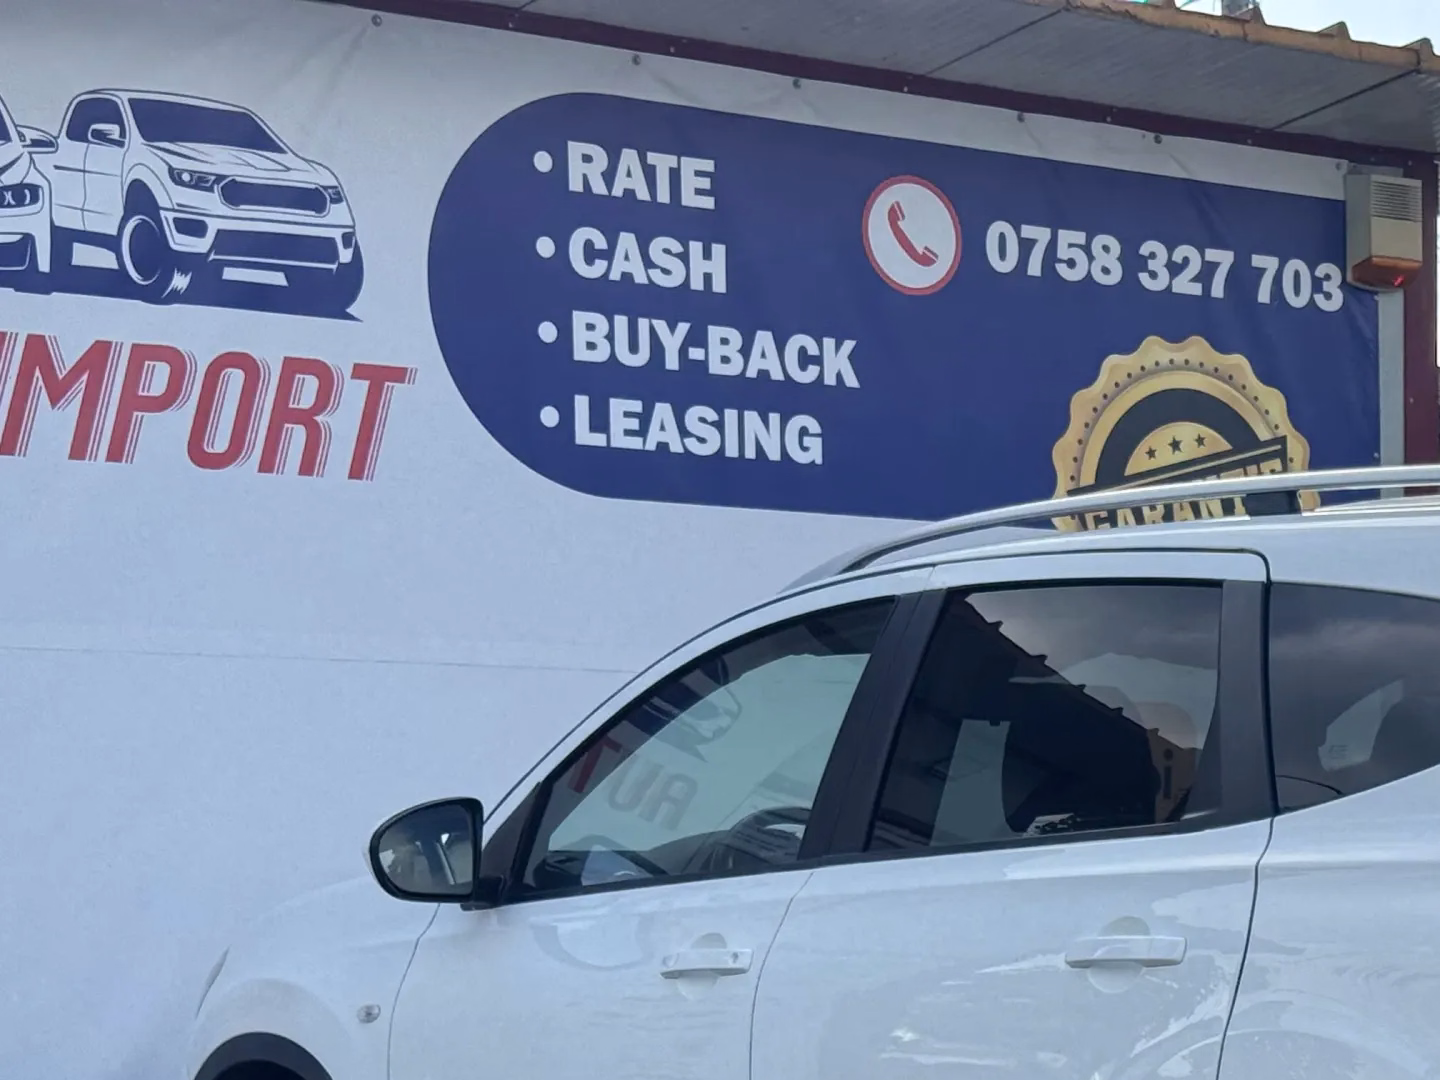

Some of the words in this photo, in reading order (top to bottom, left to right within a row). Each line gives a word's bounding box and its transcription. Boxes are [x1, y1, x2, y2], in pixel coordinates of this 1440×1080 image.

[567, 140, 716, 210] RATE
[568, 226, 727, 294] CASH
[985, 220, 1124, 287] 0758
[1137, 239, 1235, 299] 327
[1250, 254, 1345, 312] 703
[572, 310, 861, 389] BUY-BACK
[0, 331, 419, 482] MPORT
[574, 394, 823, 465] LEASING
